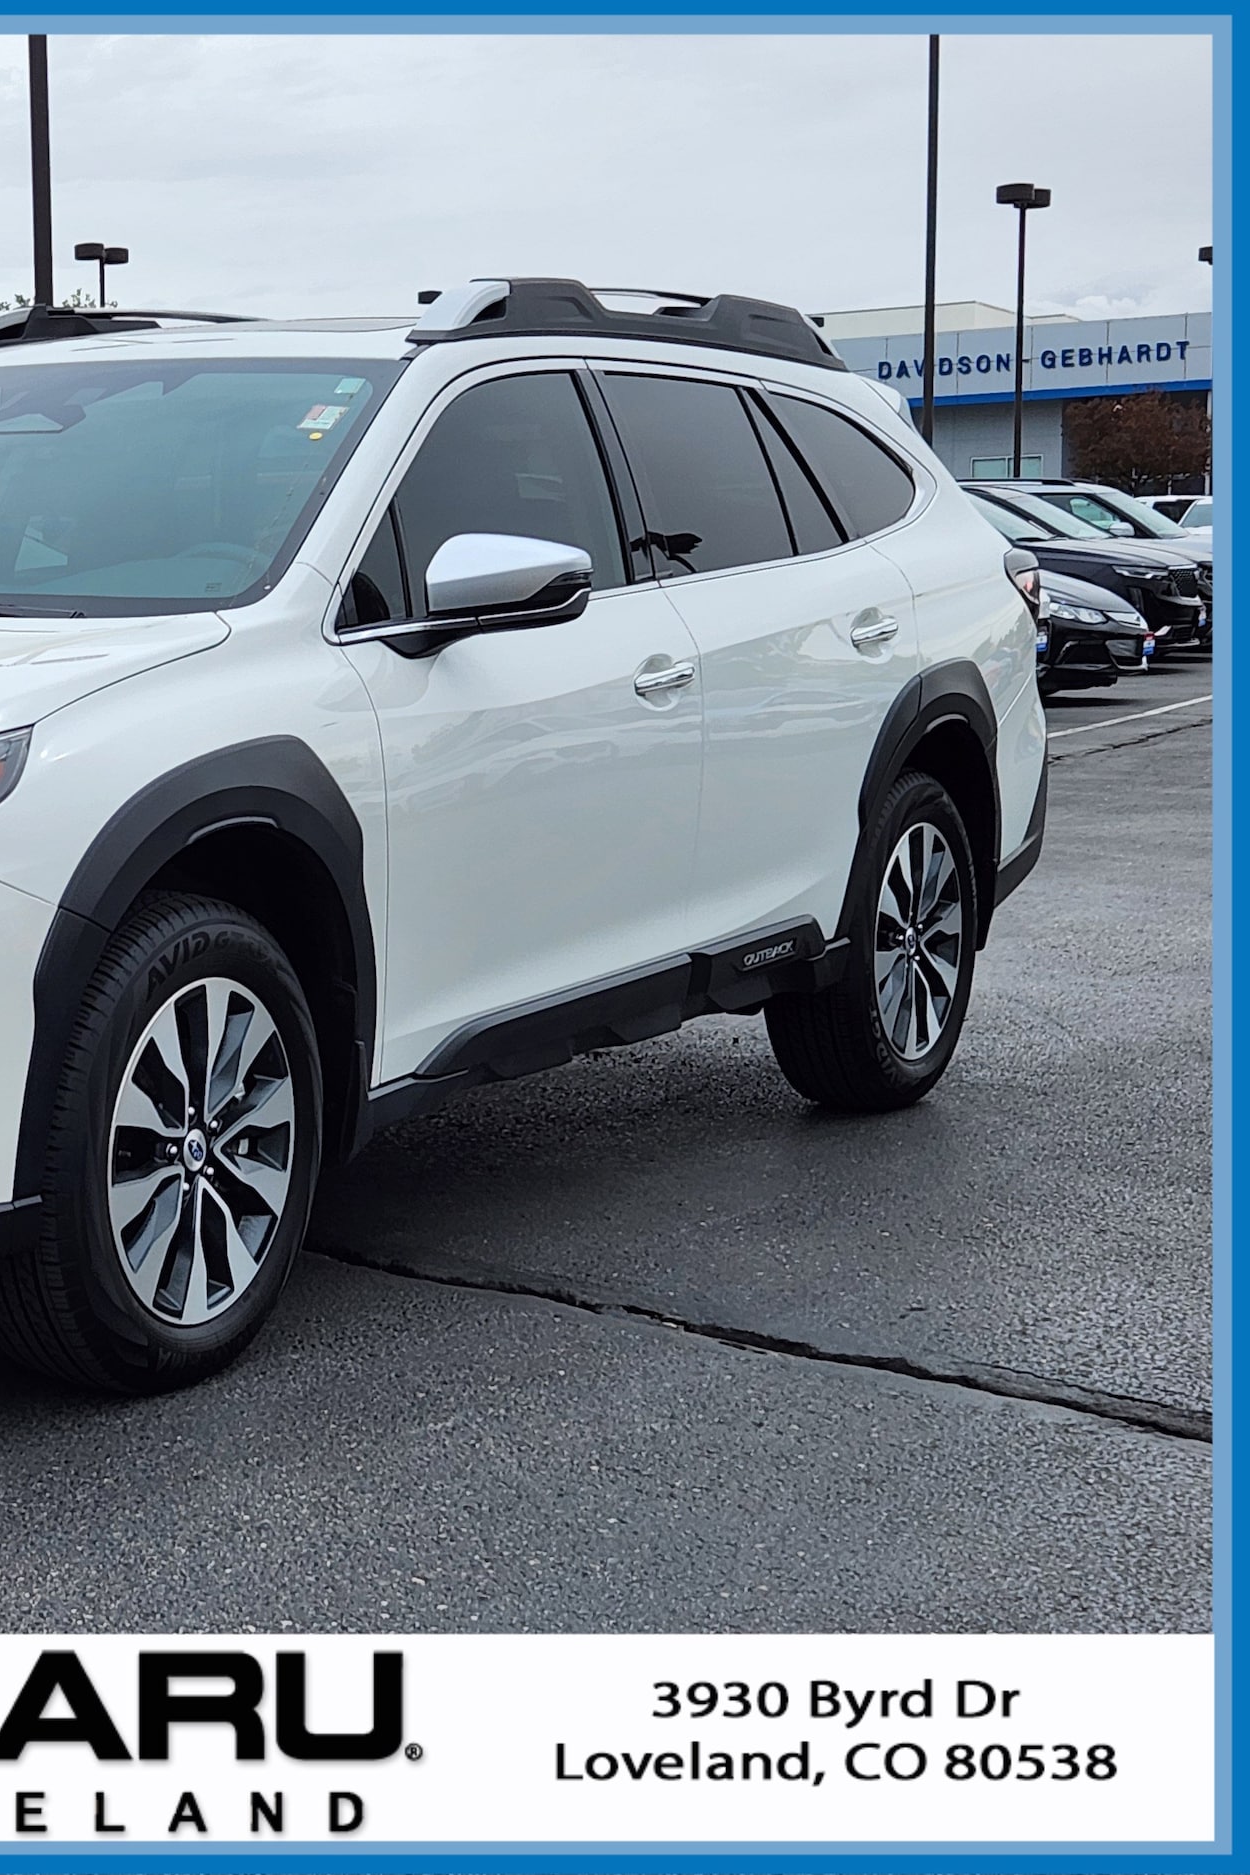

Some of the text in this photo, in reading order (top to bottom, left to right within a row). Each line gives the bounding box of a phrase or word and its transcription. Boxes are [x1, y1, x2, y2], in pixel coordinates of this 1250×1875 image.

[878, 353, 1010, 380] DAVDSON
[1040, 340, 1190, 369] GEBHARDT
[743, 940, 794, 966] OUTBACK
